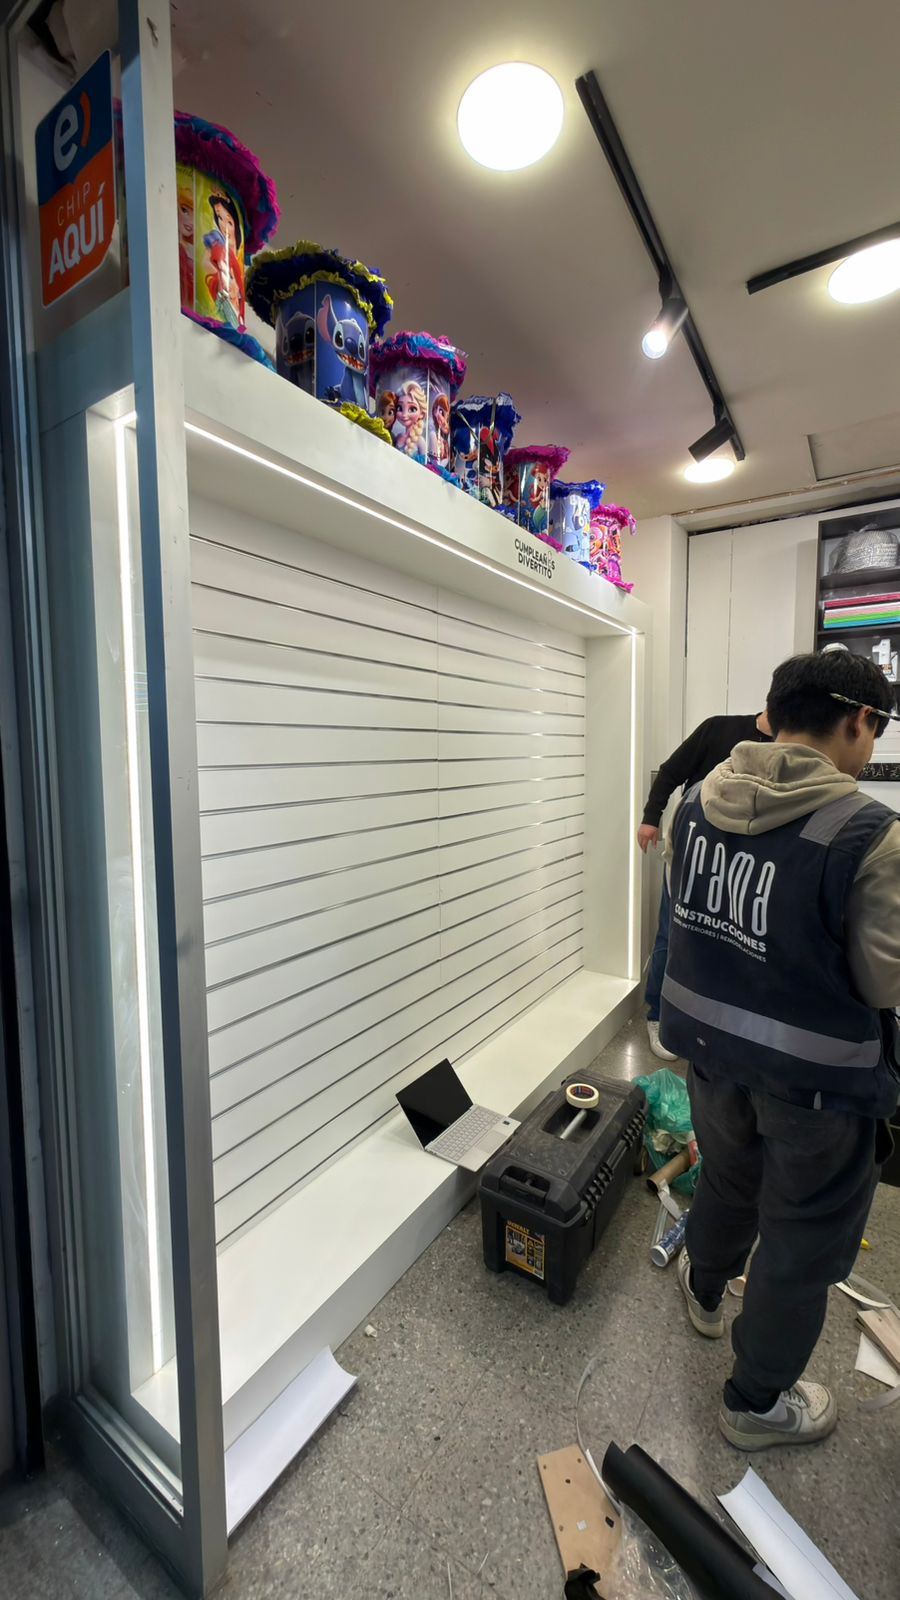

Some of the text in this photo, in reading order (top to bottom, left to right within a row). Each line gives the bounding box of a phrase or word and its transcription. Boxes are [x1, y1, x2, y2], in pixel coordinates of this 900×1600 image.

[57, 182, 90, 226] CHIP
[48, 181, 105, 285] AQUÍ
[518, 552, 553, 579] DIVERTITO
[674, 903, 767, 953] CONSTRUCCIONES
